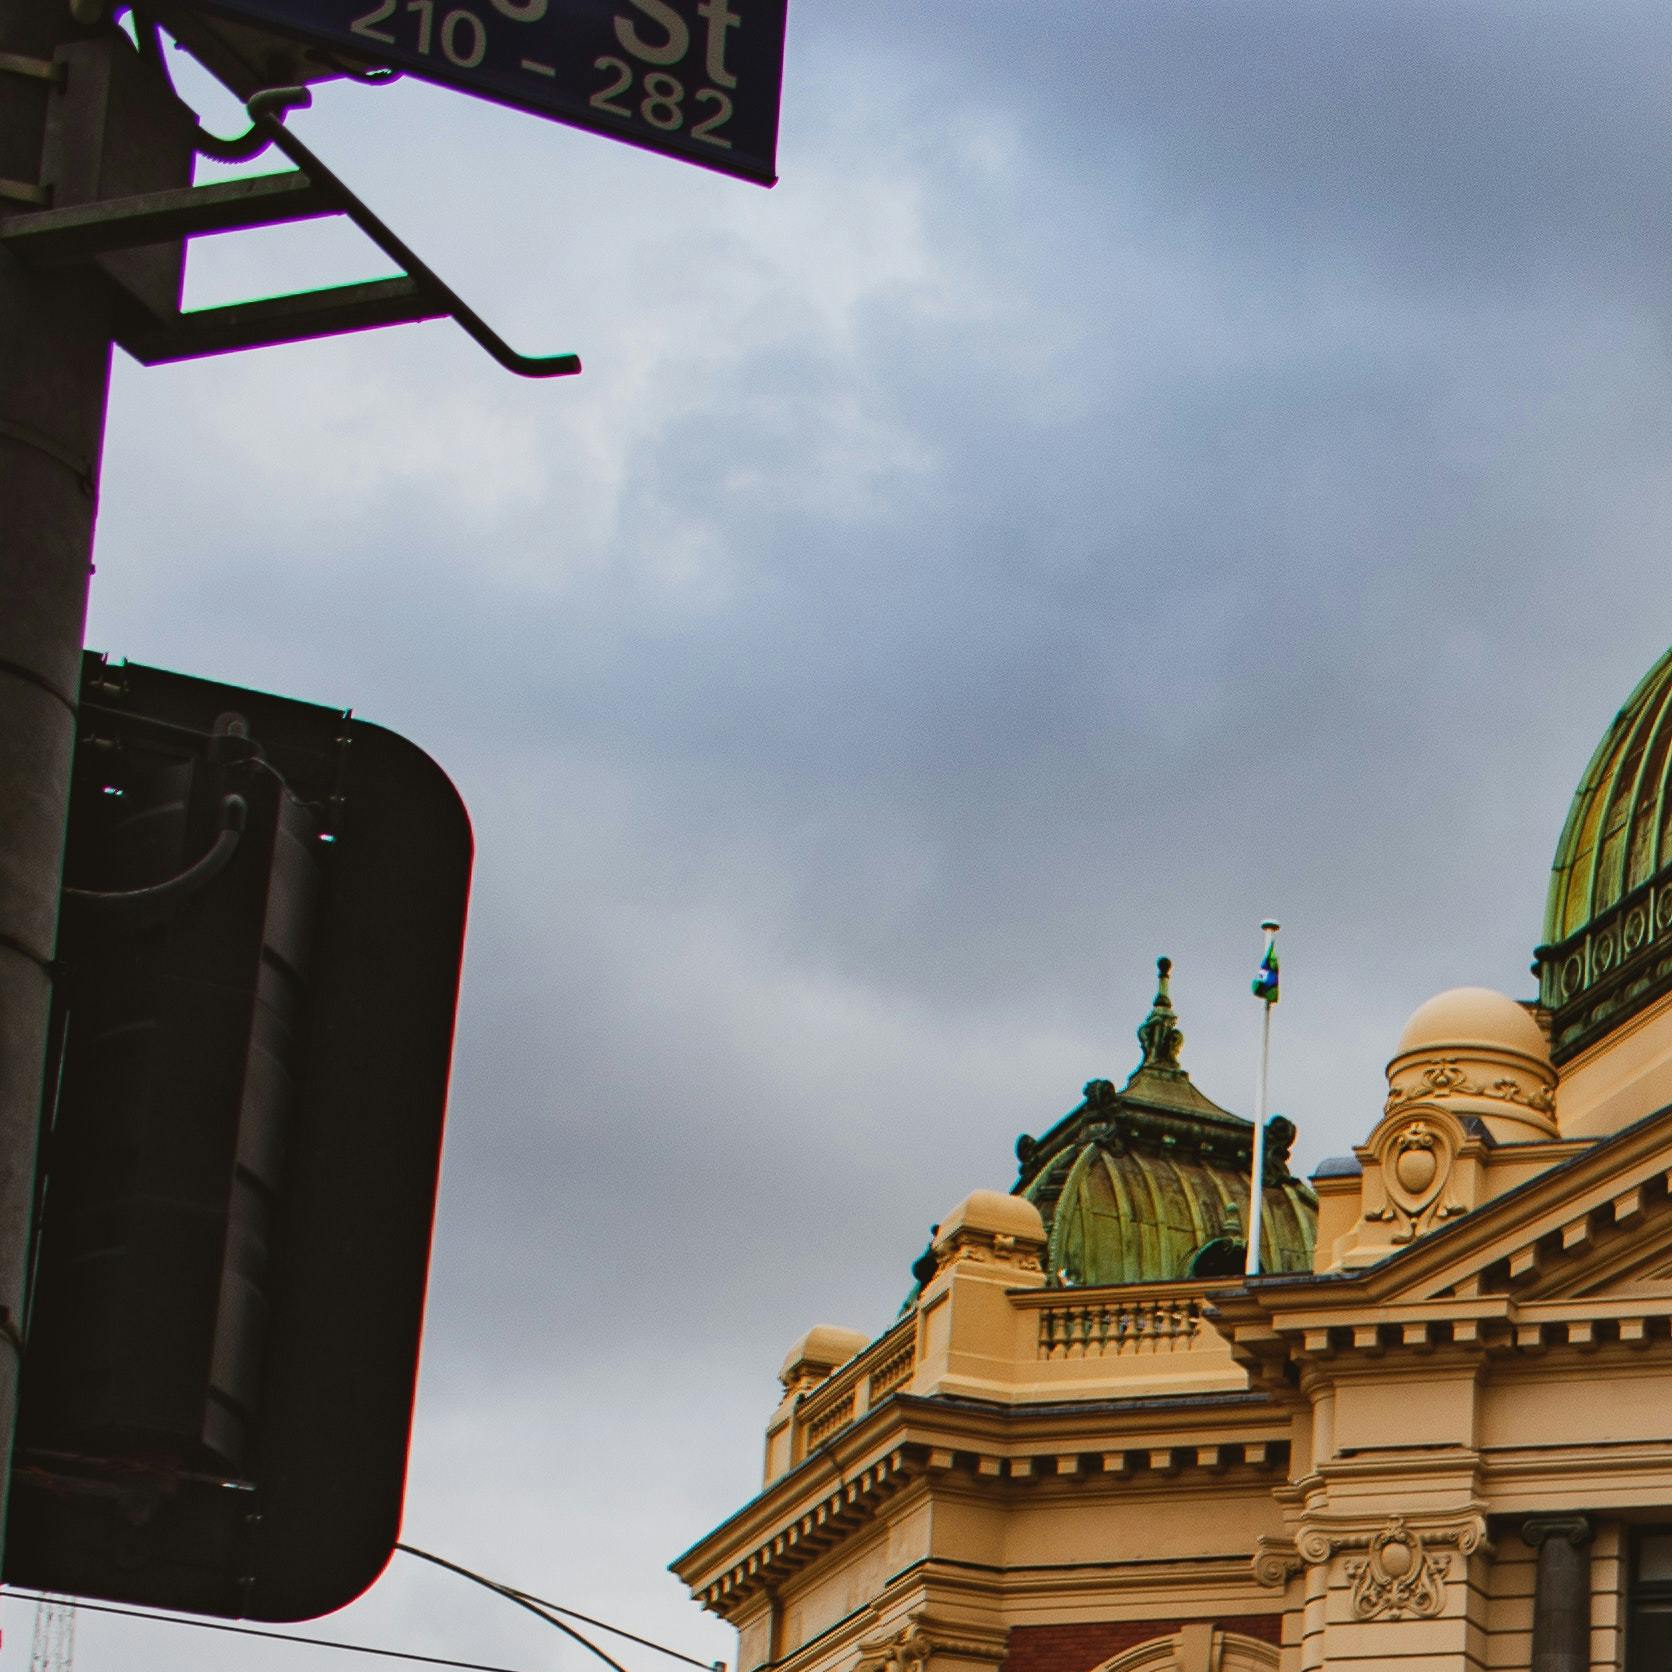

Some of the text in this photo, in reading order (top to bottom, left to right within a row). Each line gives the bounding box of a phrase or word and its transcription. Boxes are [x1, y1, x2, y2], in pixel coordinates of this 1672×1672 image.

[350, 0, 488, 68] 210
[589, 55, 734, 149] 282
[613, 0, 742, 89] St
